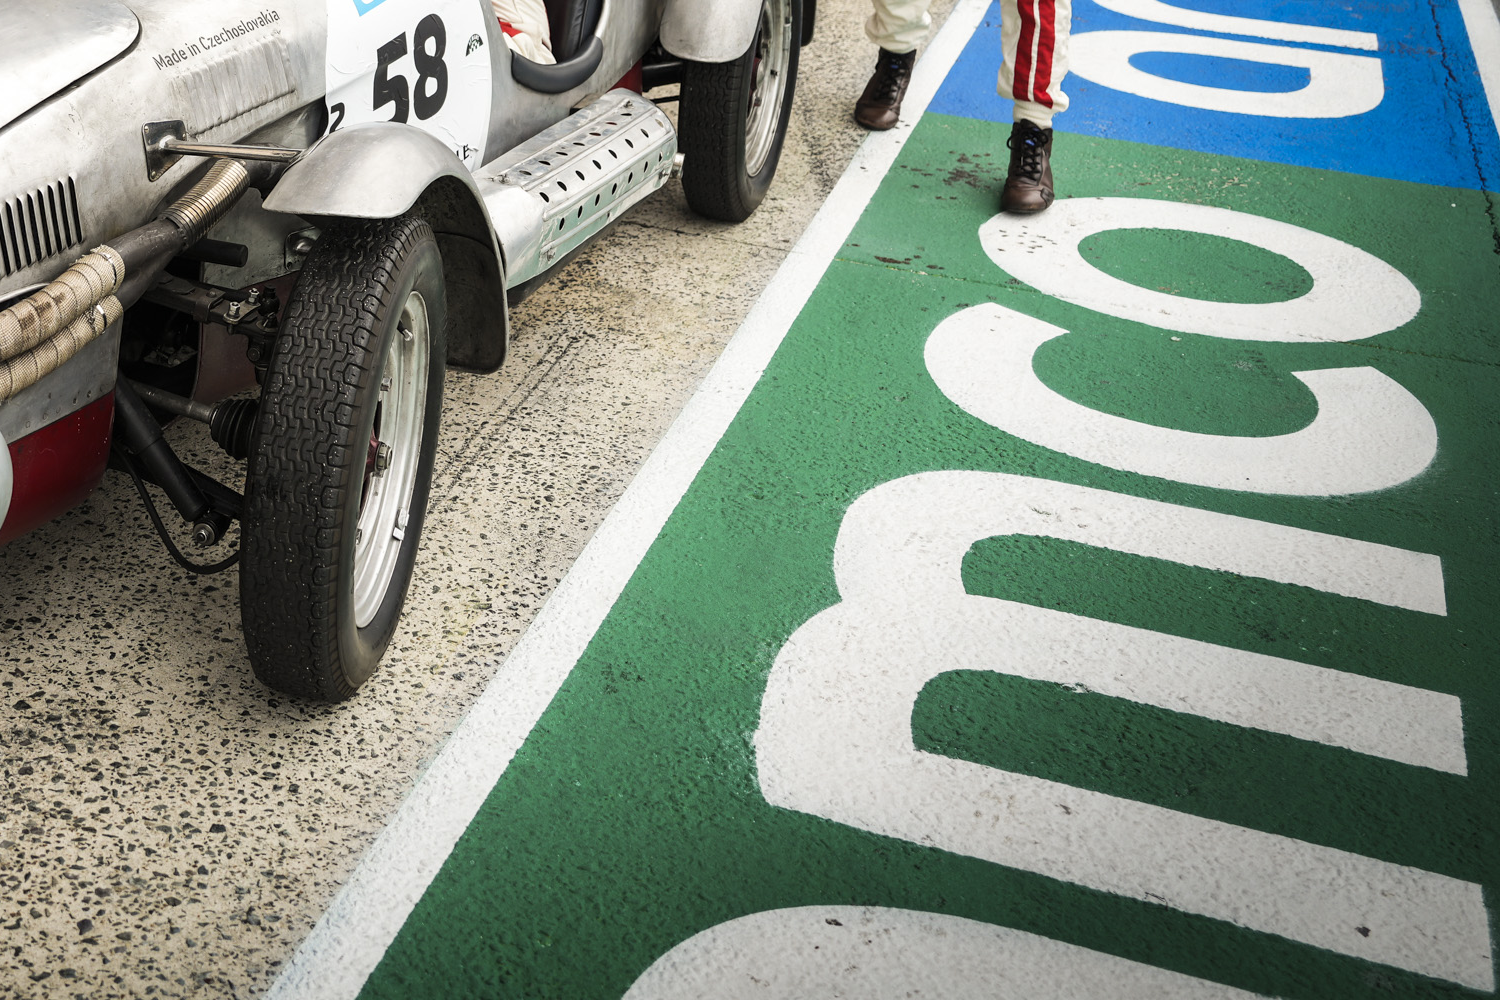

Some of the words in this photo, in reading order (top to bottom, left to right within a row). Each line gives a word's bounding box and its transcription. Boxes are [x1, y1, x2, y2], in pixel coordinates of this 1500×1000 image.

[152, 48, 188, 71] Made
[184, 42, 202, 57] in
[198, 8, 281, 51] Czechoslovakia
[373, 13, 448, 125] 58
[620, 195, 1497, 1000] mco
